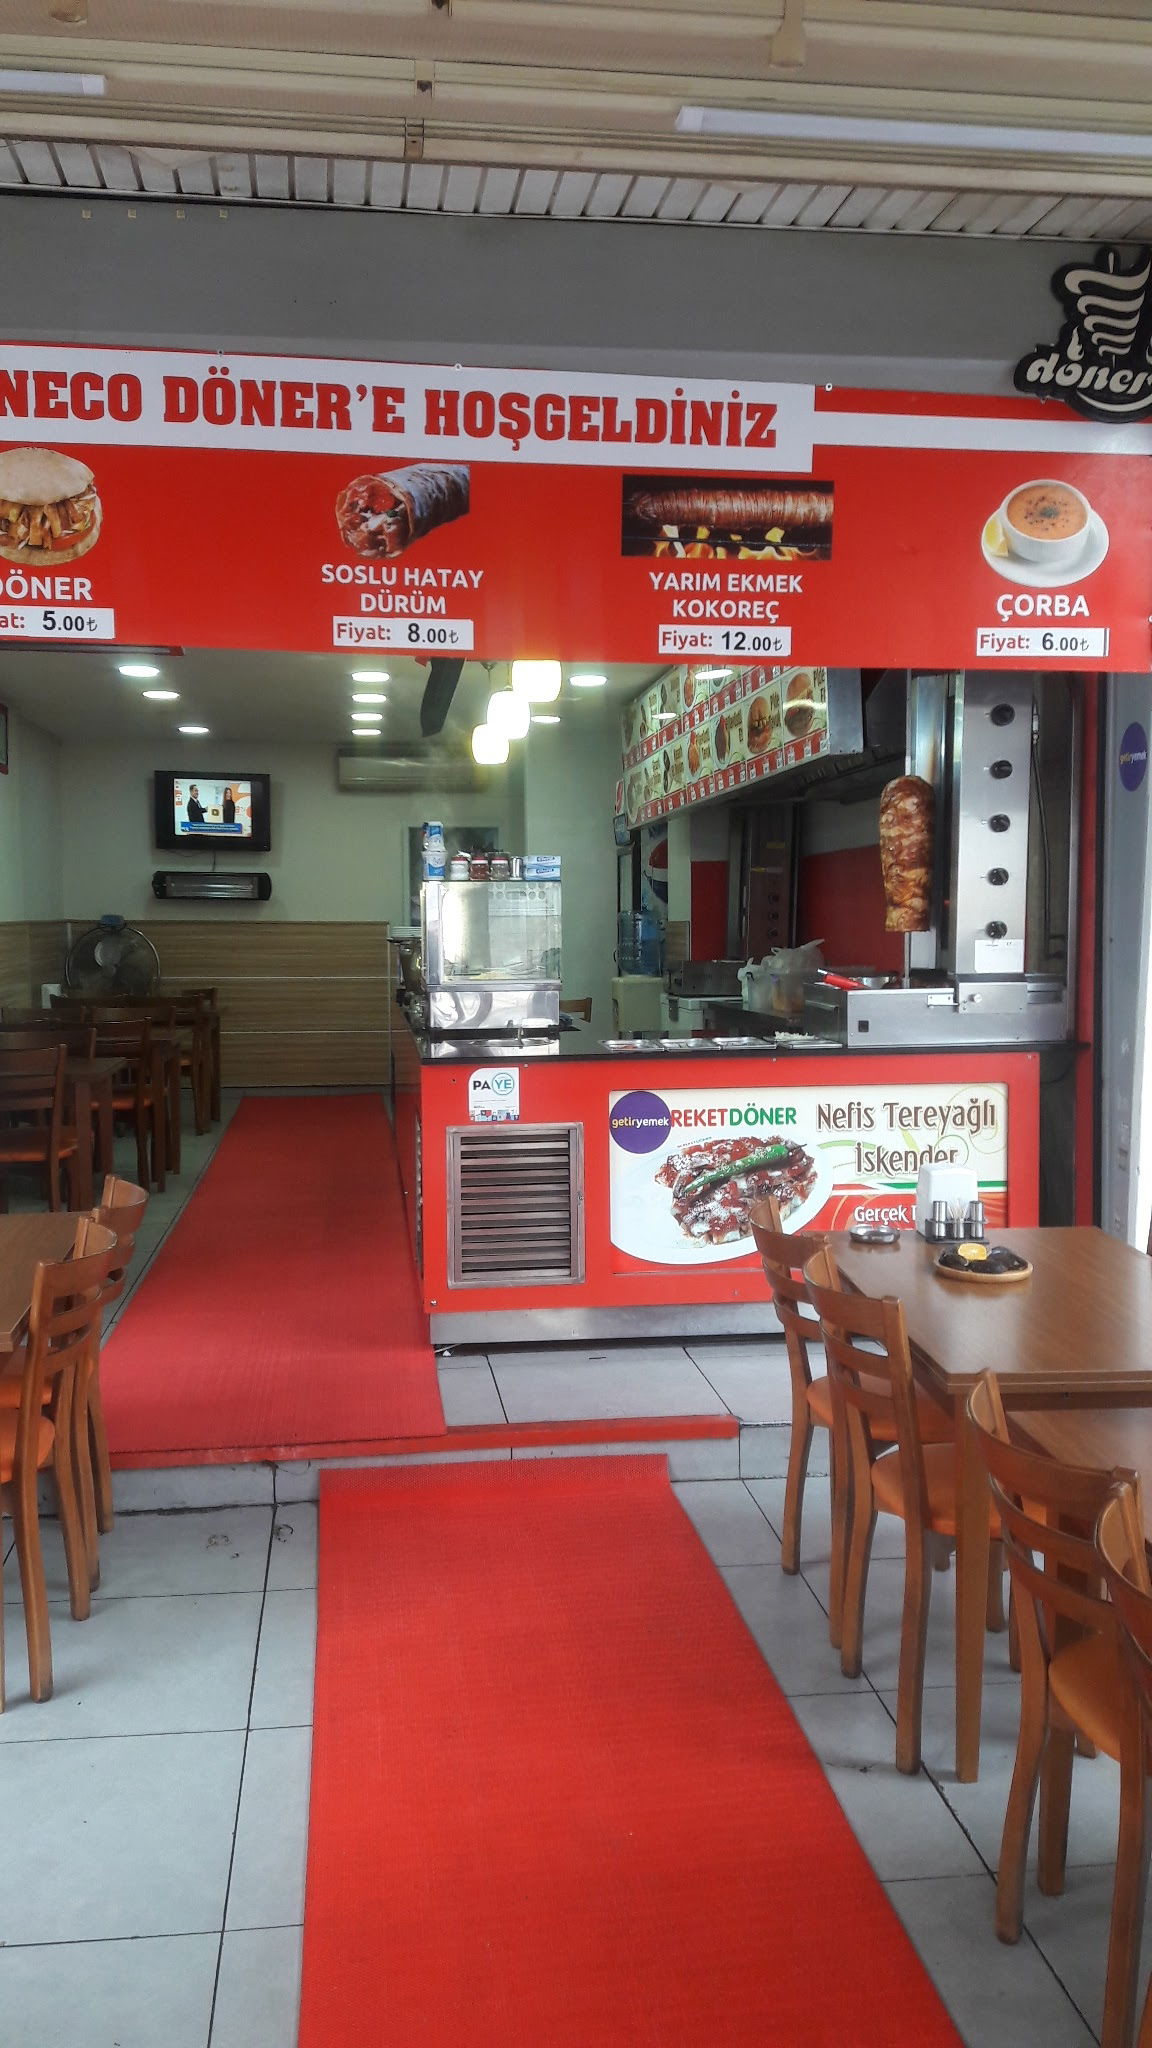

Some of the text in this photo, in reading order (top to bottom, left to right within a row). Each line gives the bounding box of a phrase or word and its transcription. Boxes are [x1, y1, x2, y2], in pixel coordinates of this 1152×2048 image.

[0, 365, 777, 451] NECO DÖNER'E HOŞGELDİNİZ
[321, 563, 484, 588] SOSLU HATAY
[649, 572, 803, 593] YARIM EKMEK
[360, 589, 446, 614] DÜRÜM
[672, 599, 779, 624] KOKOREÇ
[996, 593, 1090, 622] ÇORBA
[336, 622, 391, 643] Fiyat:
[662, 630, 713, 650] Fiyat:
[980, 633, 1030, 652] Fiyat:
[612, 1116, 669, 1129] getiryemek
[817, 1098, 996, 1136] Nefis Tereyağlı
[854, 1205, 910, 1226] Gerçek
